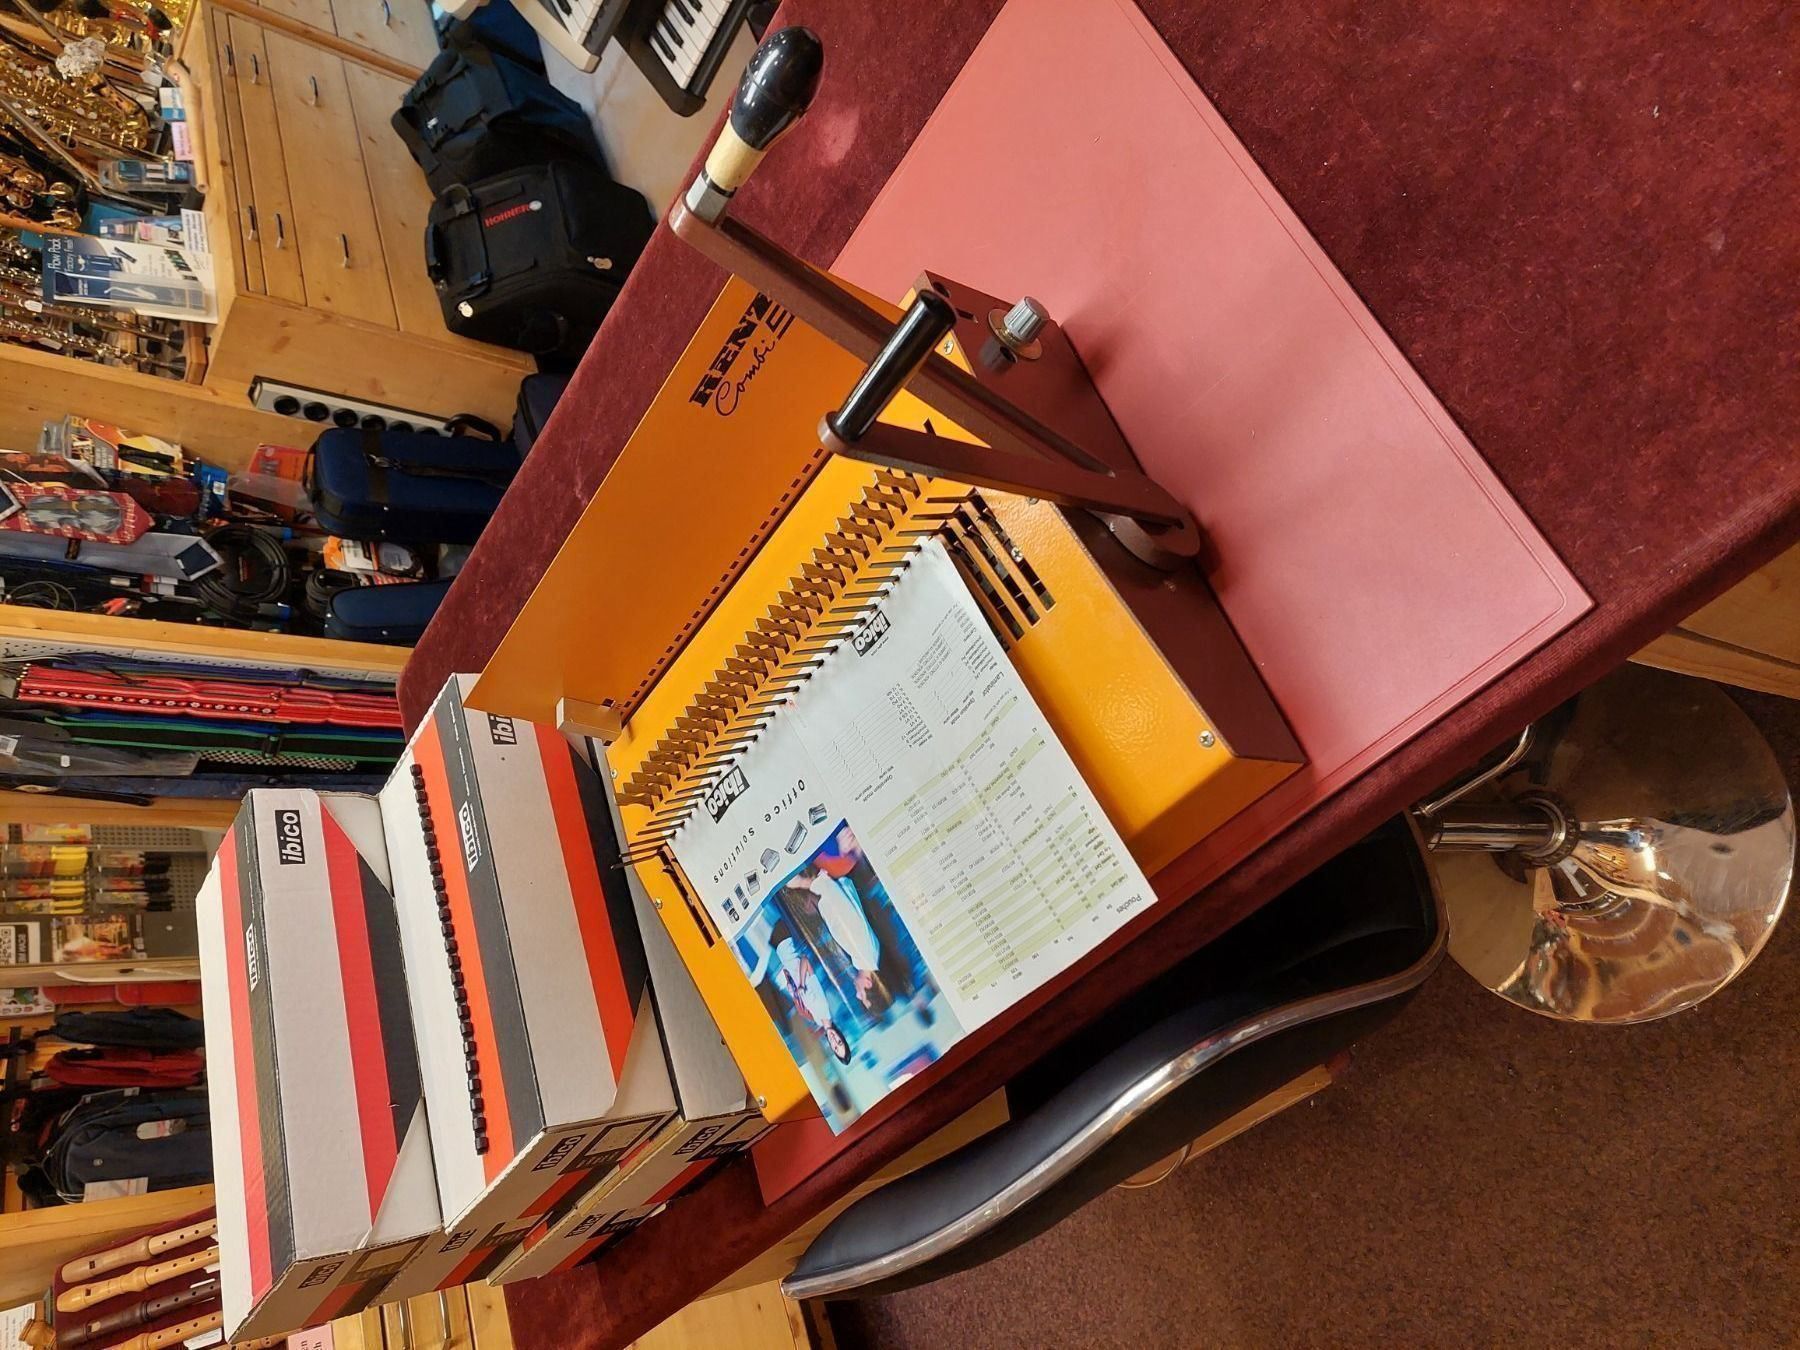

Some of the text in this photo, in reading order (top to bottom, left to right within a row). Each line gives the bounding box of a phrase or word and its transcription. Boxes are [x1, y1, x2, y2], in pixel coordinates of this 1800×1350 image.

[688, 292, 773, 407] RENZ
[715, 340, 775, 416] Combi
[852, 610, 889, 657] ibico
[981, 670, 1004, 696] Laminator
[490, 713, 516, 744] ibi
[704, 766, 746, 821] ibico
[279, 811, 304, 863] ibico
[461, 805, 478, 865] ibico
[711, 778, 806, 885] Office solutions
[1115, 892, 1142, 916] Pouches
[245, 926, 258, 985] ibico
[536, 1135, 584, 1170] ibico
[678, 1126, 721, 1154] ibico
